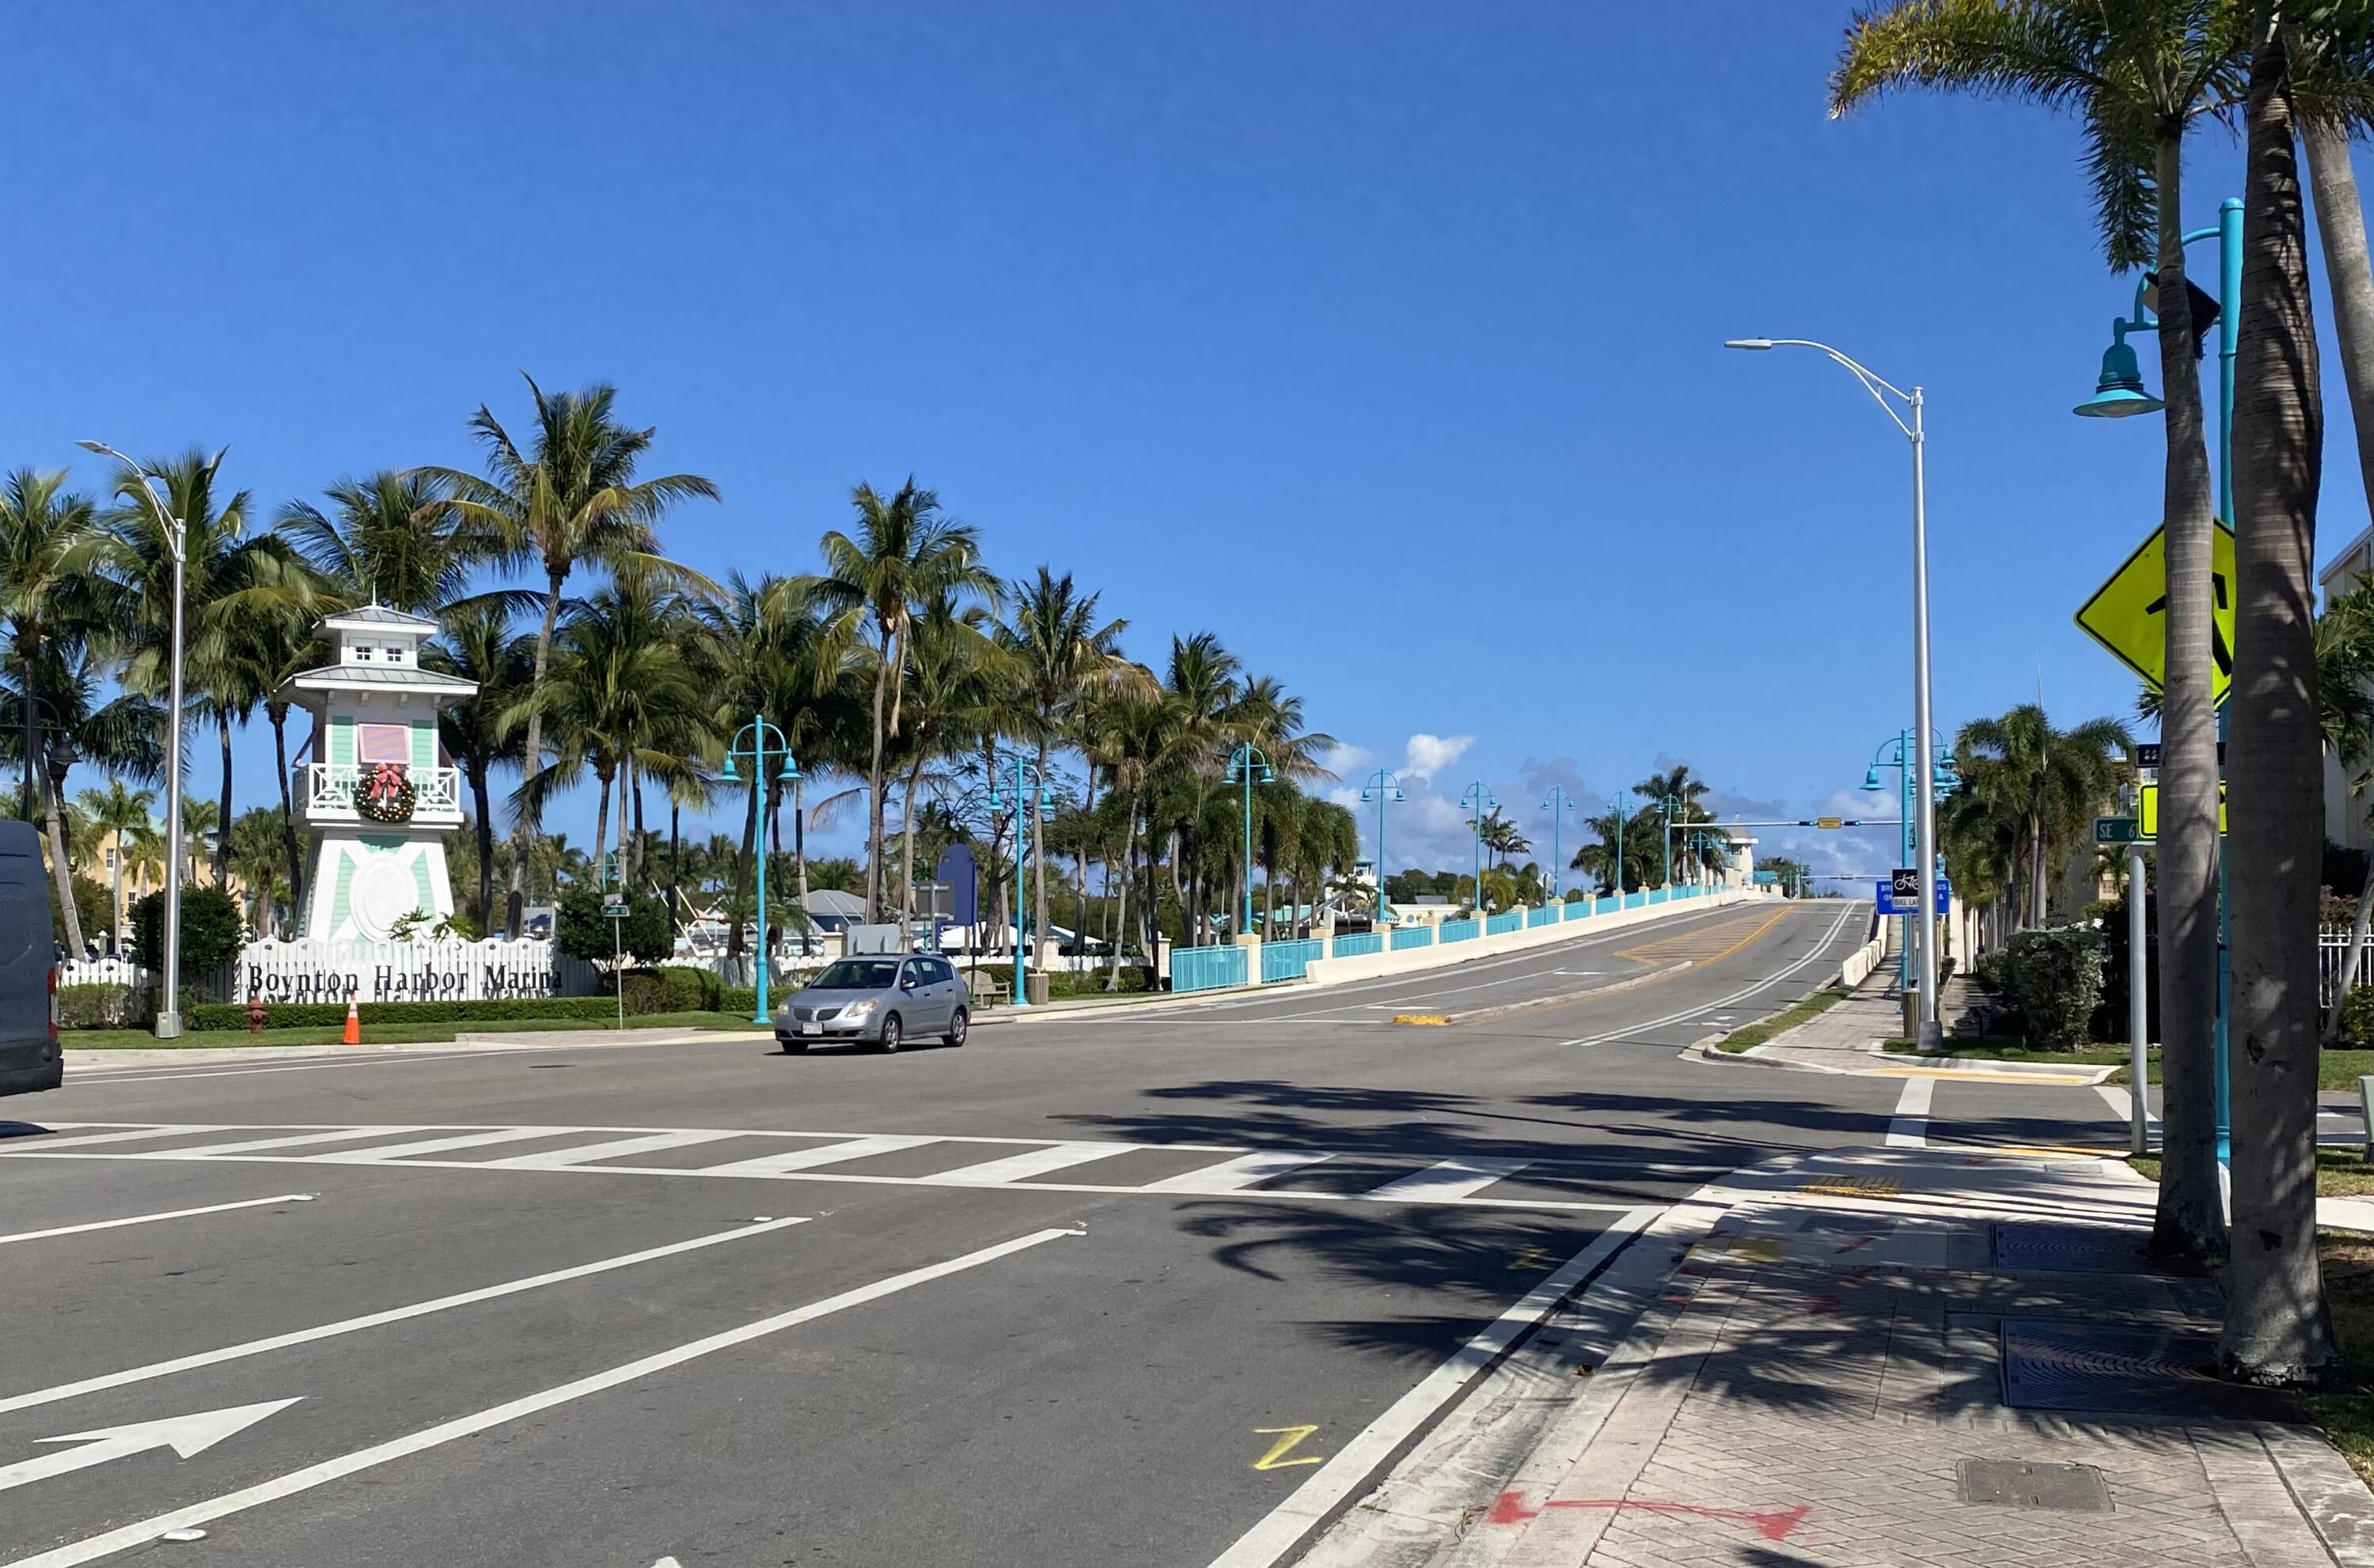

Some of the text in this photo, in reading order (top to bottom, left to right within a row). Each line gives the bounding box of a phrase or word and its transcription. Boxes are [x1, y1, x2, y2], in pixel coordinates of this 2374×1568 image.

[2099, 824, 2113, 839] SE
[1894, 898, 1918, 907] BIKE LA
[248, 962, 563, 994] Boynton Harbor Marina
